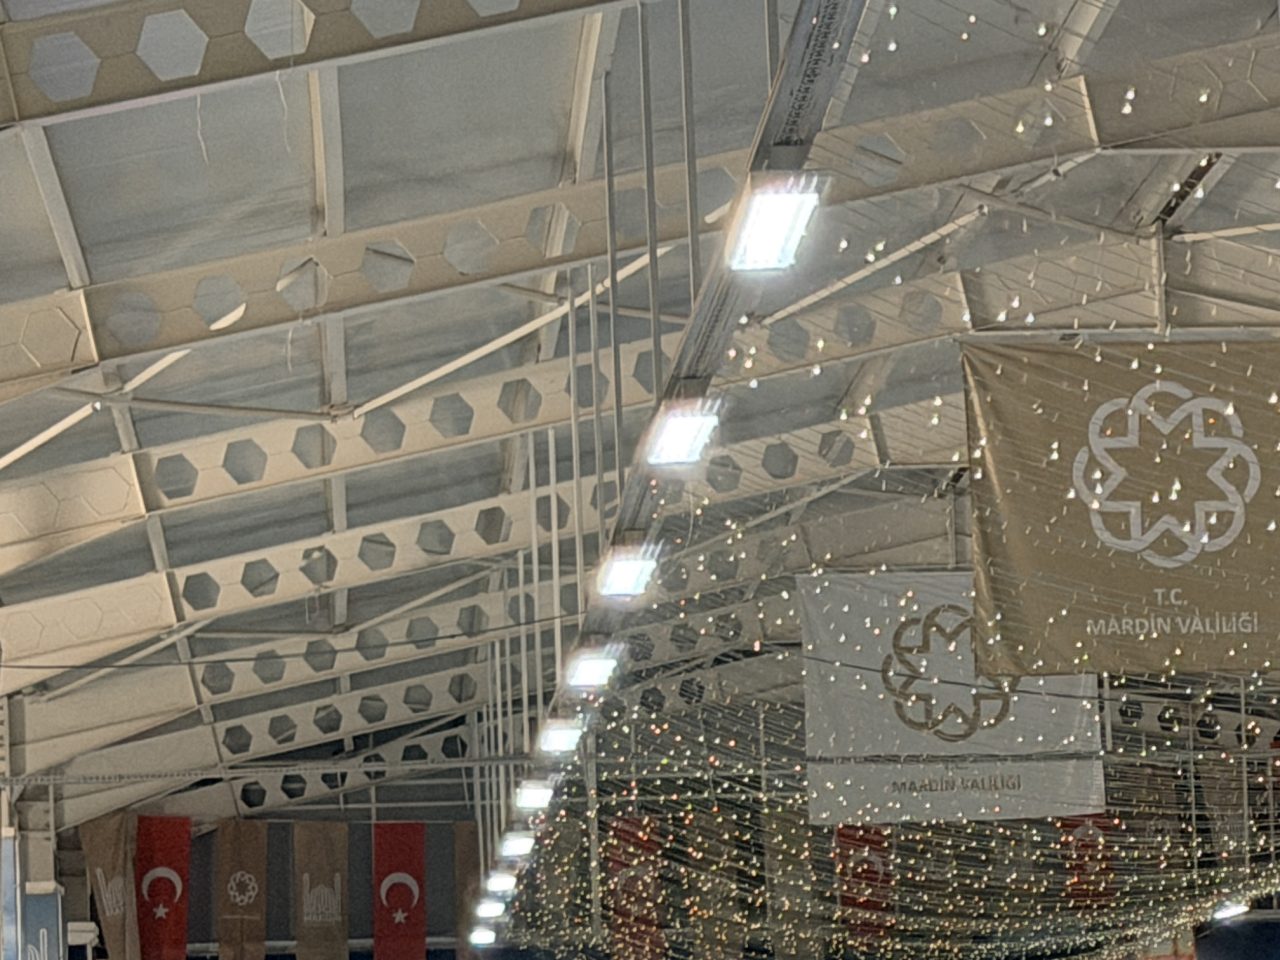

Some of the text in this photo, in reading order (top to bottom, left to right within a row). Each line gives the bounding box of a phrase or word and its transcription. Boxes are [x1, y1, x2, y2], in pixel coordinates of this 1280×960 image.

[1153, 588, 1188, 606] T.C.
[1087, 611, 1258, 635] MARDİN VALİLİĞİ
